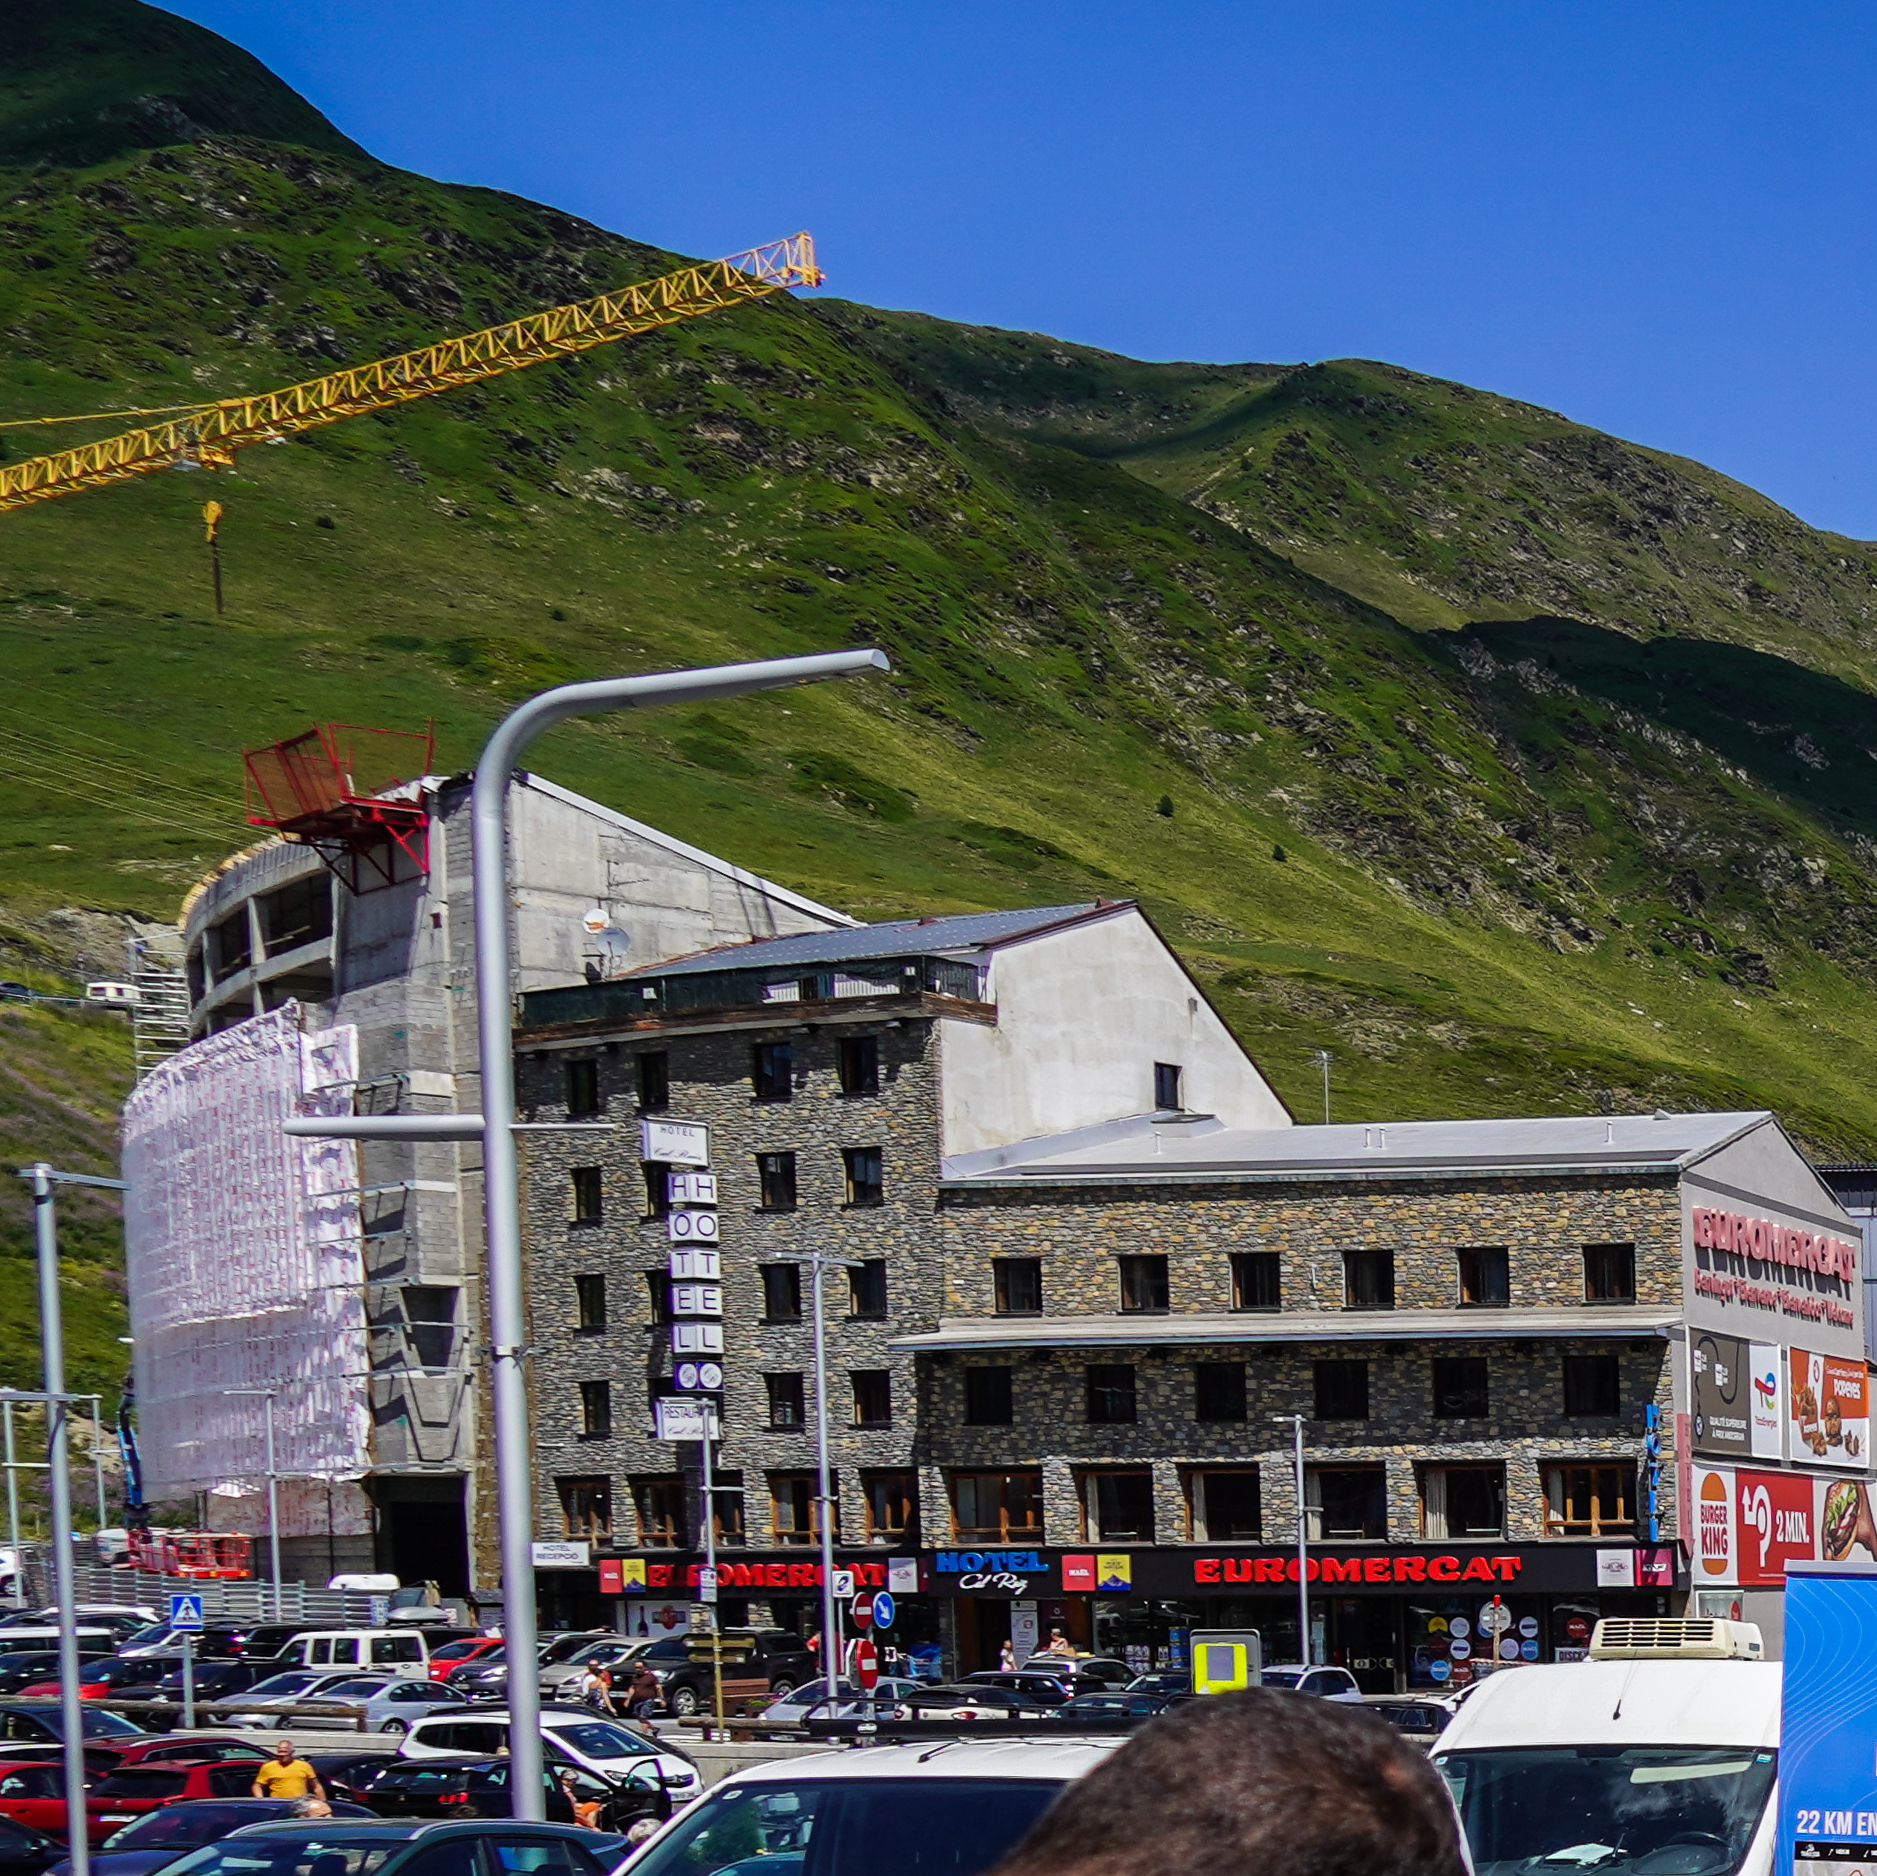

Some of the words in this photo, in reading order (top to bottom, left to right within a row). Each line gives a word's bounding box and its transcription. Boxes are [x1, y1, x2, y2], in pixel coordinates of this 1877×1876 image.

[1692, 1205, 1856, 1283] EUROMERCAT
[672, 1176, 692, 1349] HOTEL
[696, 1176, 718, 1349] HOTEL
[1700, 1504, 1728, 1526] BURGER
[1775, 1509, 1784, 1543] 2
[1785, 1510, 1810, 1544] MIN.
[1701, 1526, 1729, 1556] KING
[936, 1551, 1050, 1573] HOTEL
[1194, 1556, 1521, 1583] EUROMERCAT
[1797, 1810, 1819, 1834] 22
[1824, 1811, 1852, 1836] KM
